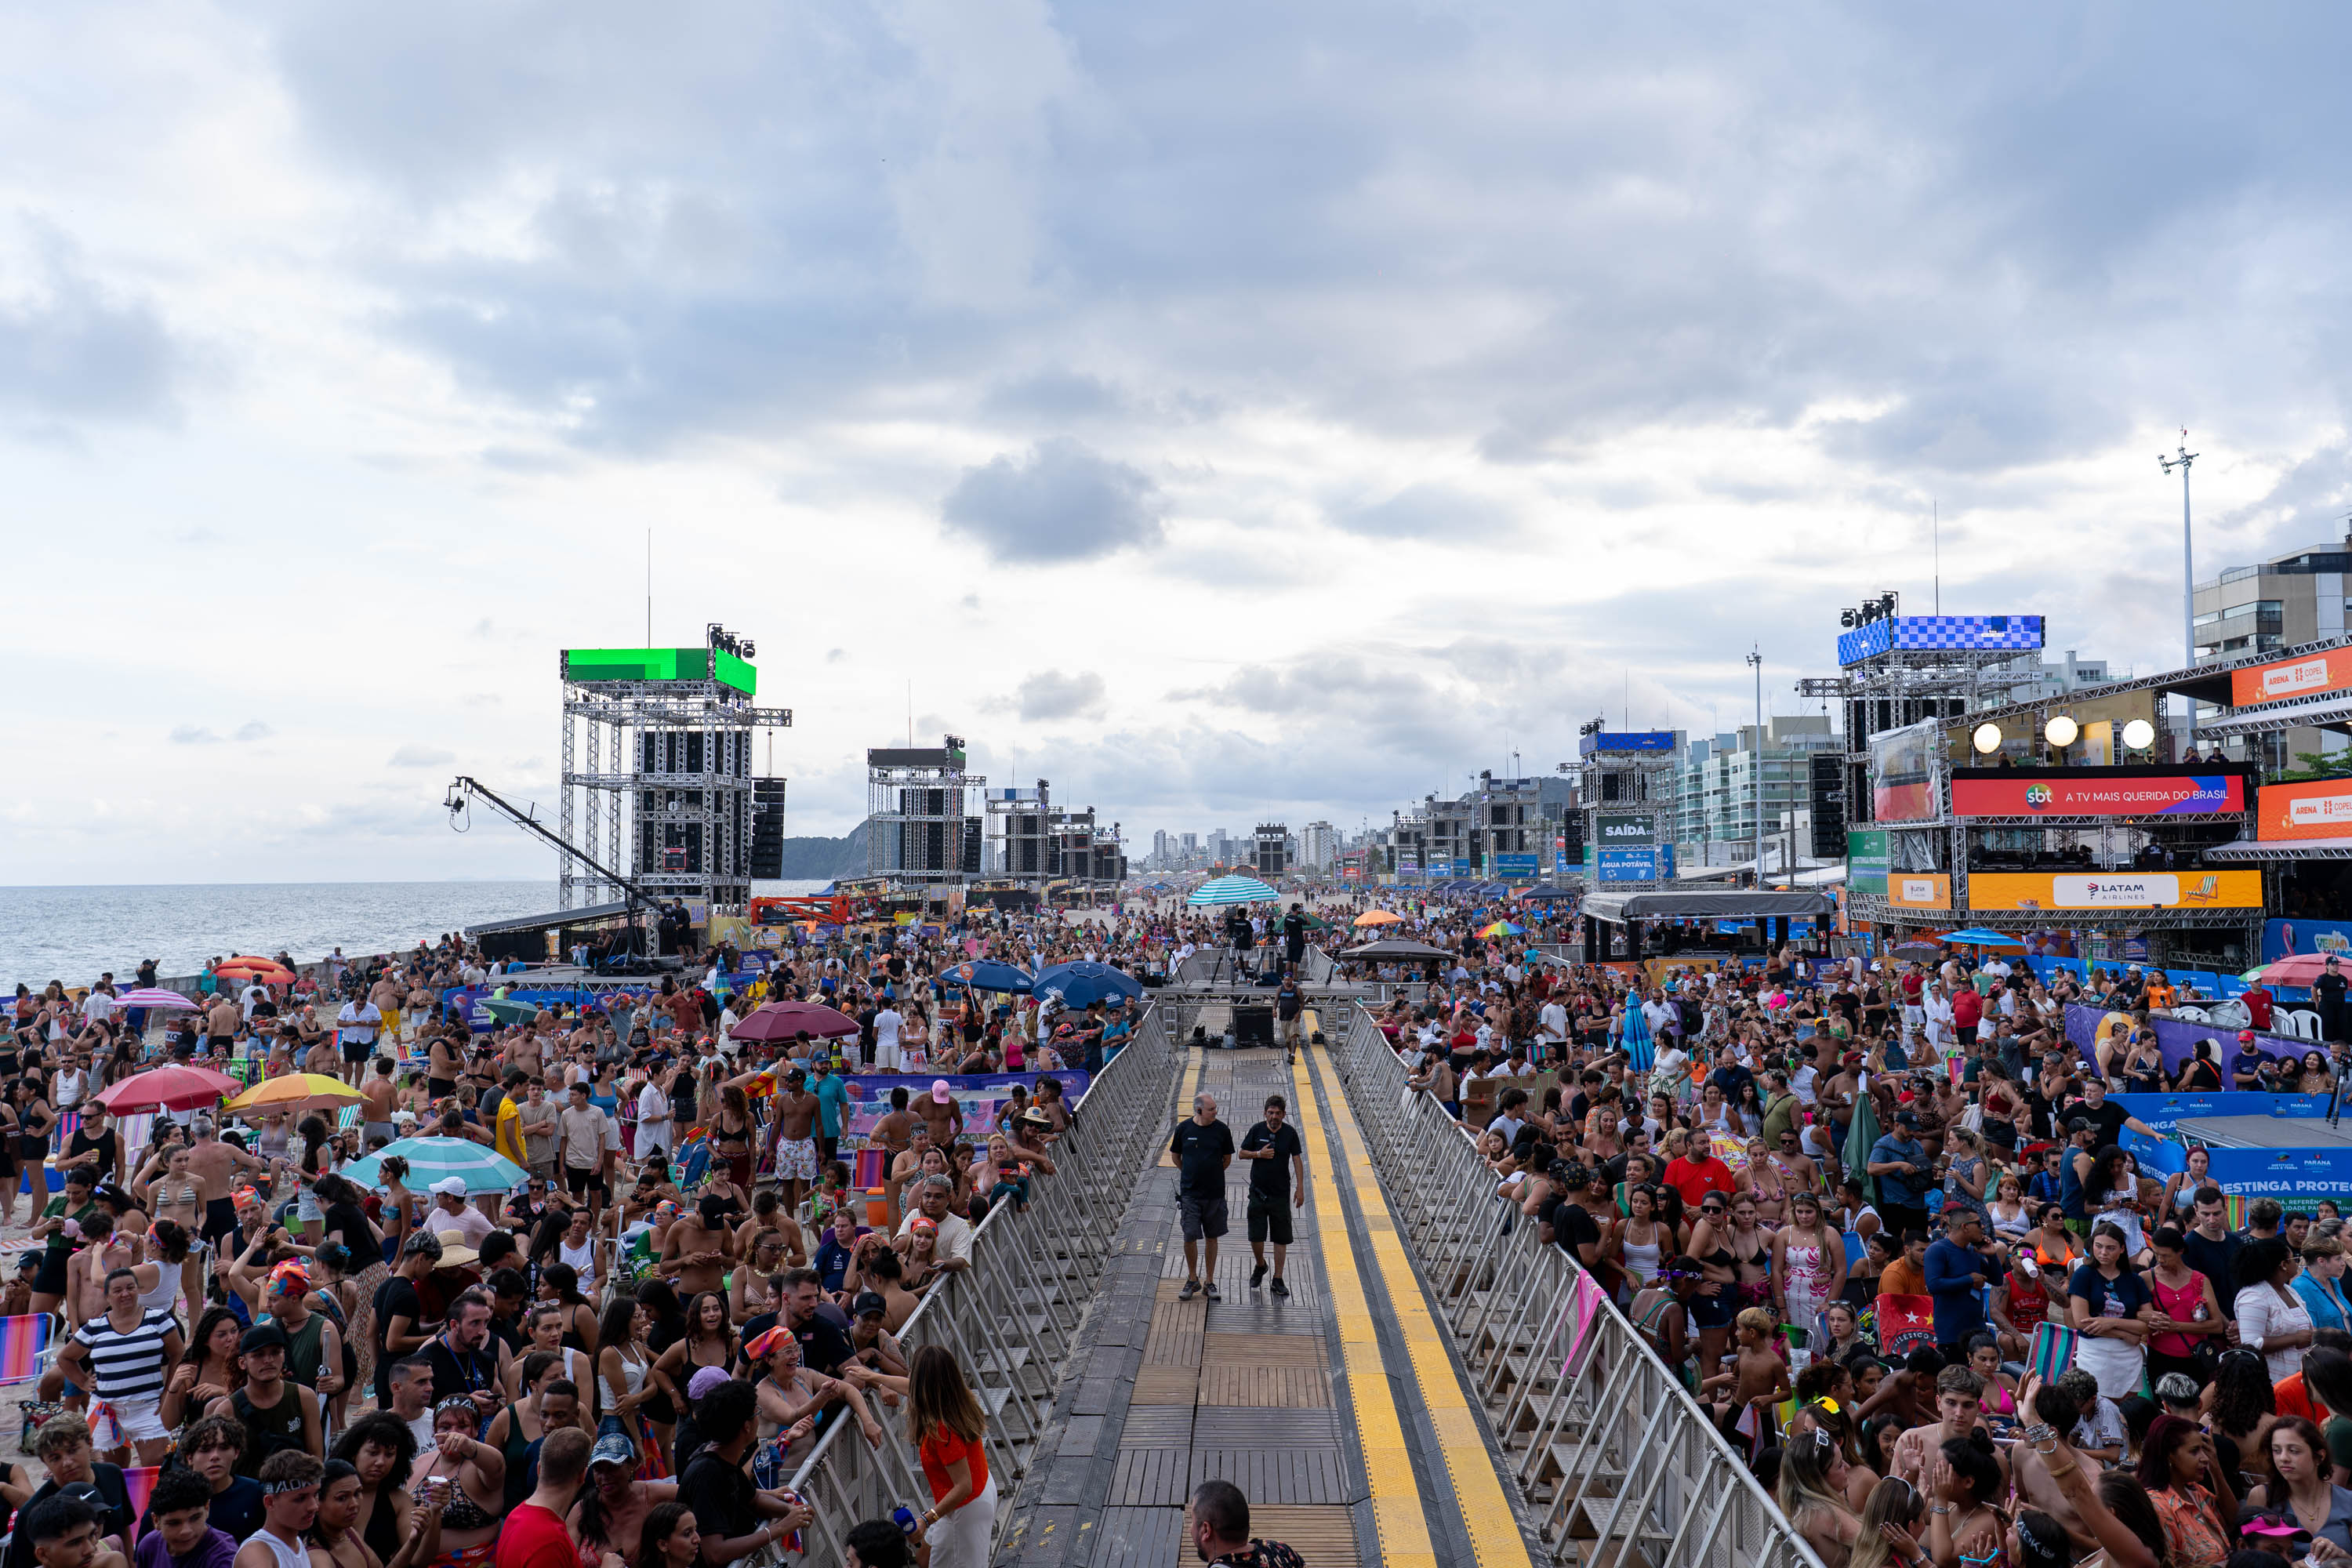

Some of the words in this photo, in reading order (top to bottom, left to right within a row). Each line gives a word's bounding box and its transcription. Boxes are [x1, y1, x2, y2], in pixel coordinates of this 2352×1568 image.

[2304, 666, 2323, 677] COPEL
[2268, 675, 2289, 686] ARENA
[2027, 787, 2053, 803] sbt
[2065, 792, 2074, 801] A
[2075, 792, 2091, 801] TV
[2093, 792, 2121, 801] MAIS
[2122, 790, 2171, 801] QUERIDA
[2172, 790, 2190, 800] DO
[2192, 789, 2230, 800] BRASIL
[2295, 806, 2318, 815] ARENA
[1605, 823, 1646, 837] SAÍDA
[691, 903, 705, 923] BAR
[2139, 1162, 2170, 1182] PROTEGID
